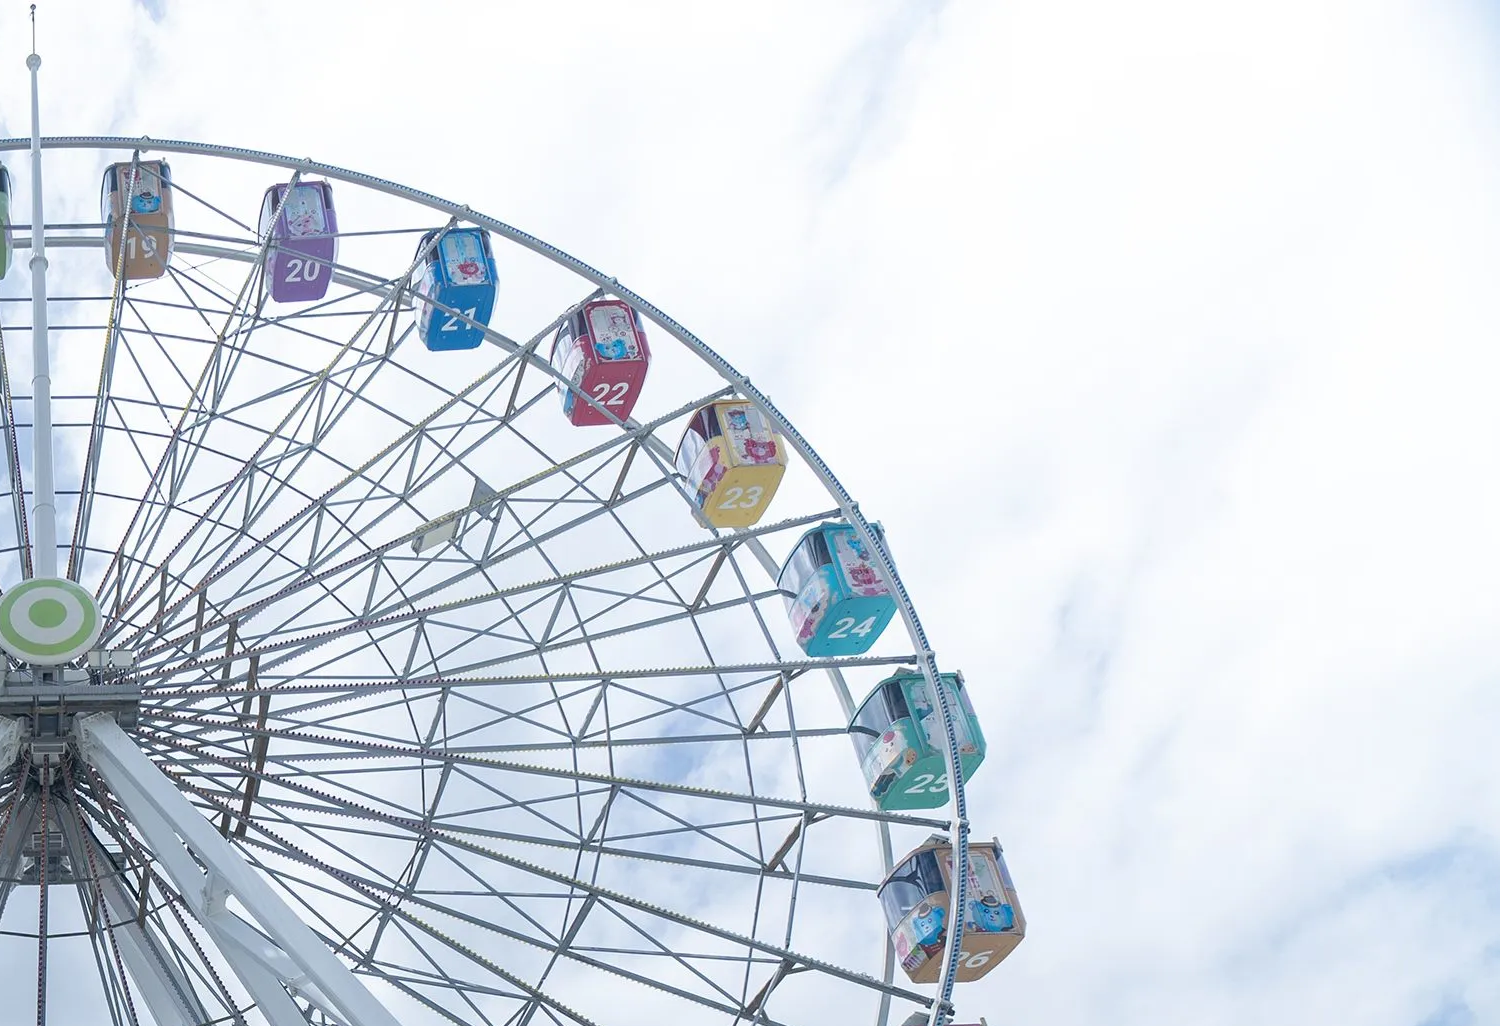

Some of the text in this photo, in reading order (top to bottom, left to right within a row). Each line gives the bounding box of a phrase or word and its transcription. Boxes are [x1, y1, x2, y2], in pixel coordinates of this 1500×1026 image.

[125, 236, 157, 259] 19
[285, 259, 320, 283] 20
[441, 308, 476, 331] 21
[588, 383, 629, 407] 22
[717, 486, 762, 509] 23
[828, 617, 875, 639] 24
[905, 773, 949, 794] 25
